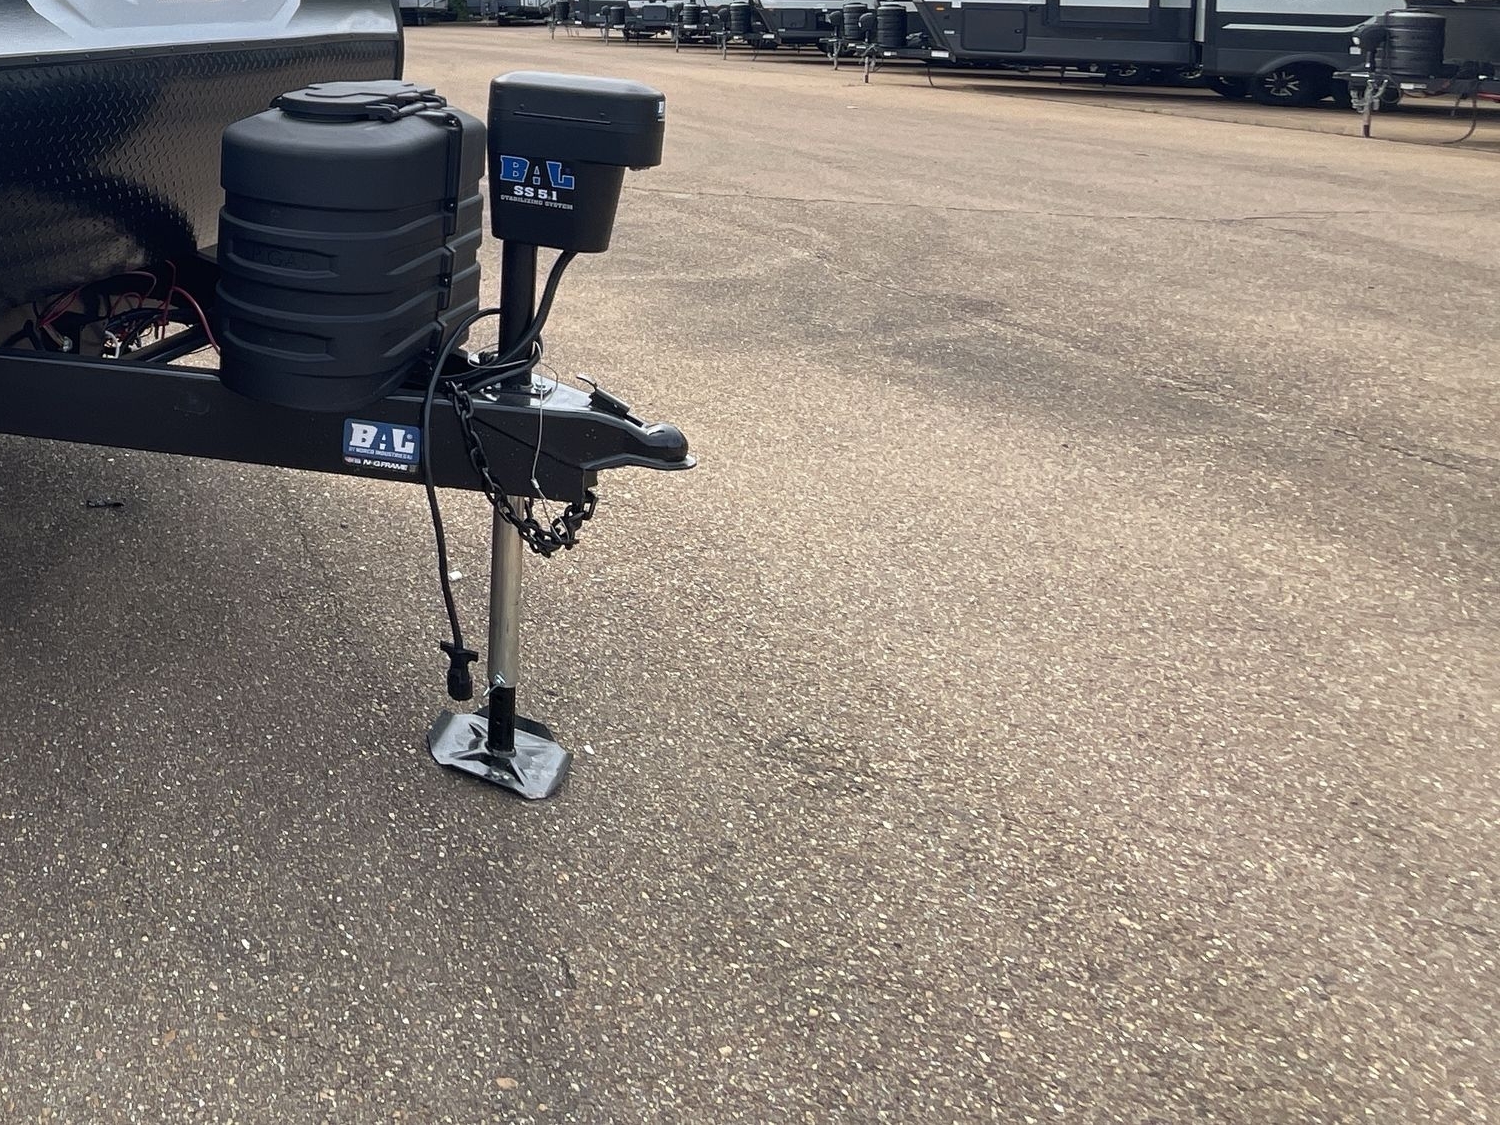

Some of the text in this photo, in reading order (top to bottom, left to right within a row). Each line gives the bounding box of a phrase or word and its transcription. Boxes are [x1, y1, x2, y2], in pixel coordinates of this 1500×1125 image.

[500, 155, 575, 191] BAL
[513, 185, 558, 201] SS 5.1
[349, 422, 415, 454] BAL
